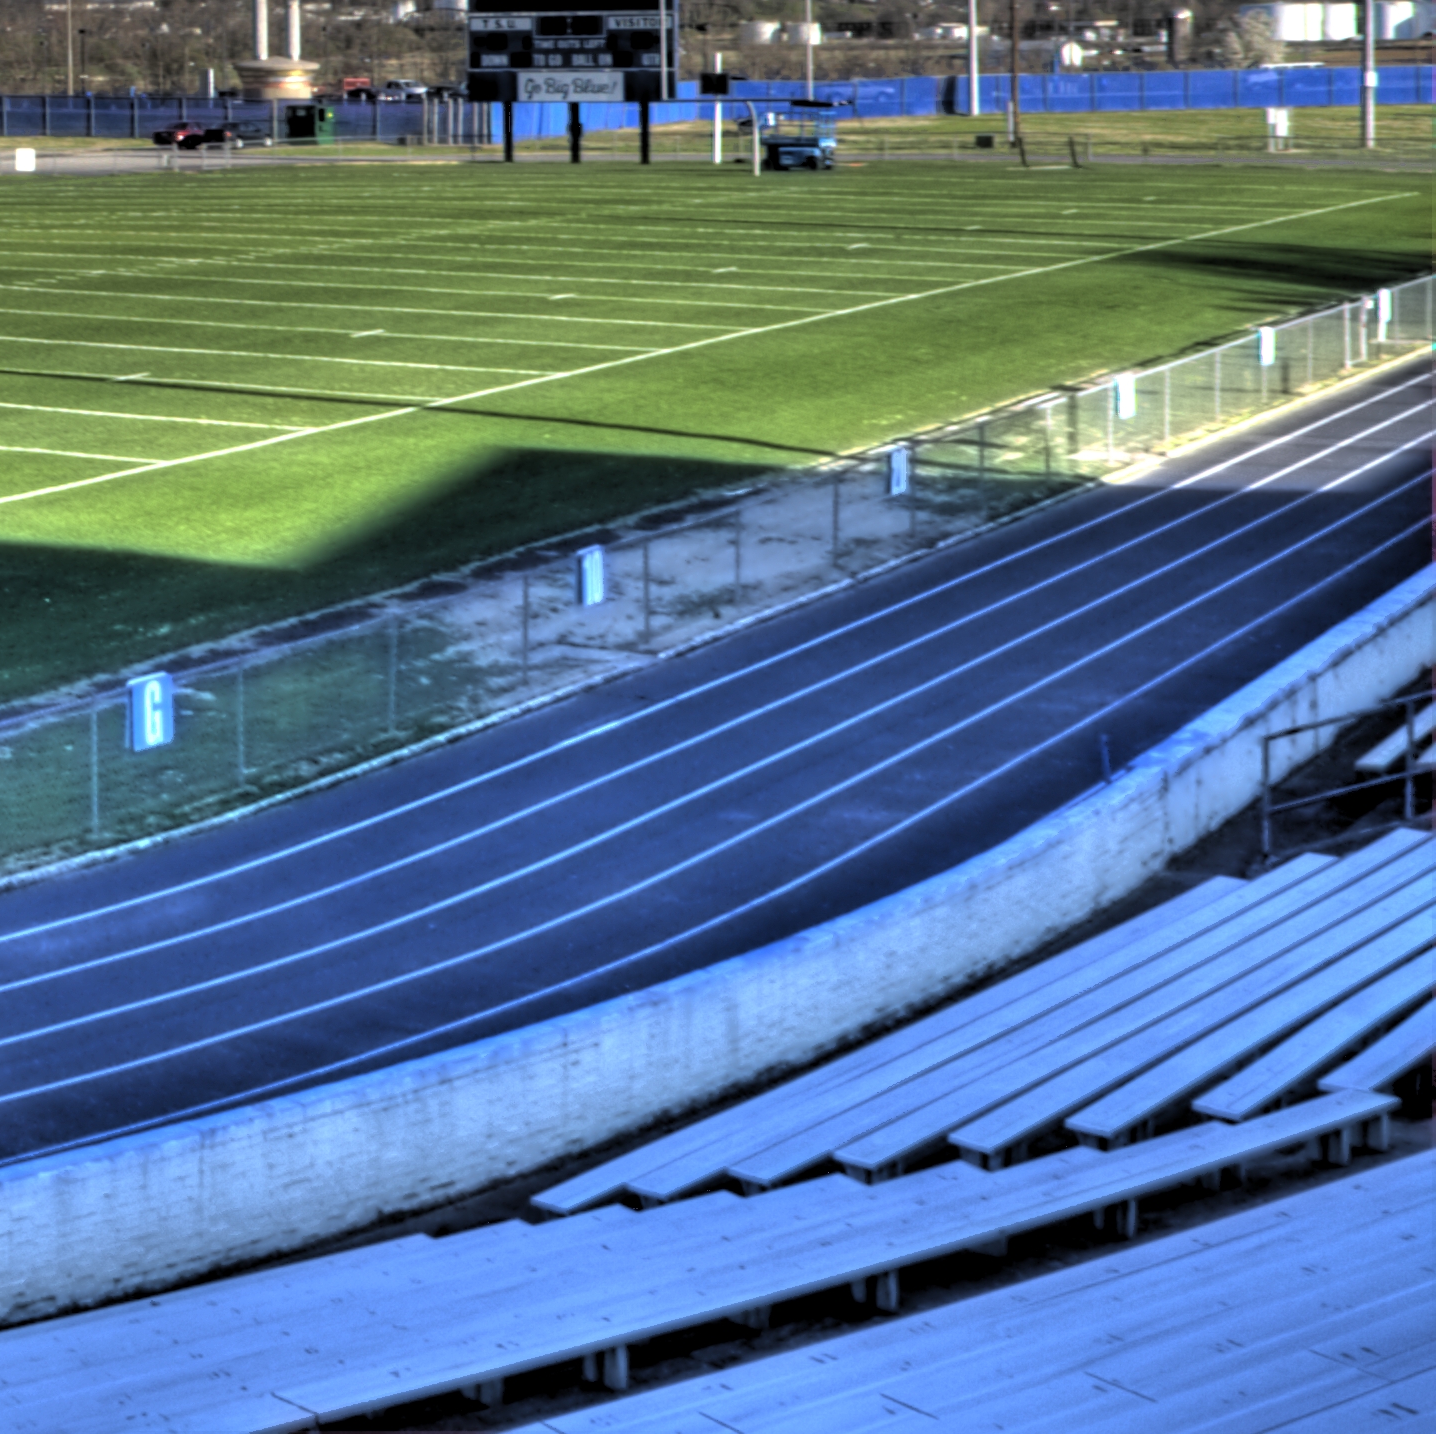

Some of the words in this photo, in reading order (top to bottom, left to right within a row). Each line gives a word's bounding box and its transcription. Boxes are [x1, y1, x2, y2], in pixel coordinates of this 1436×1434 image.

[524, 77, 542, 100] Go
[544, 77, 570, 100] Big
[144, 680, 163, 745] G
